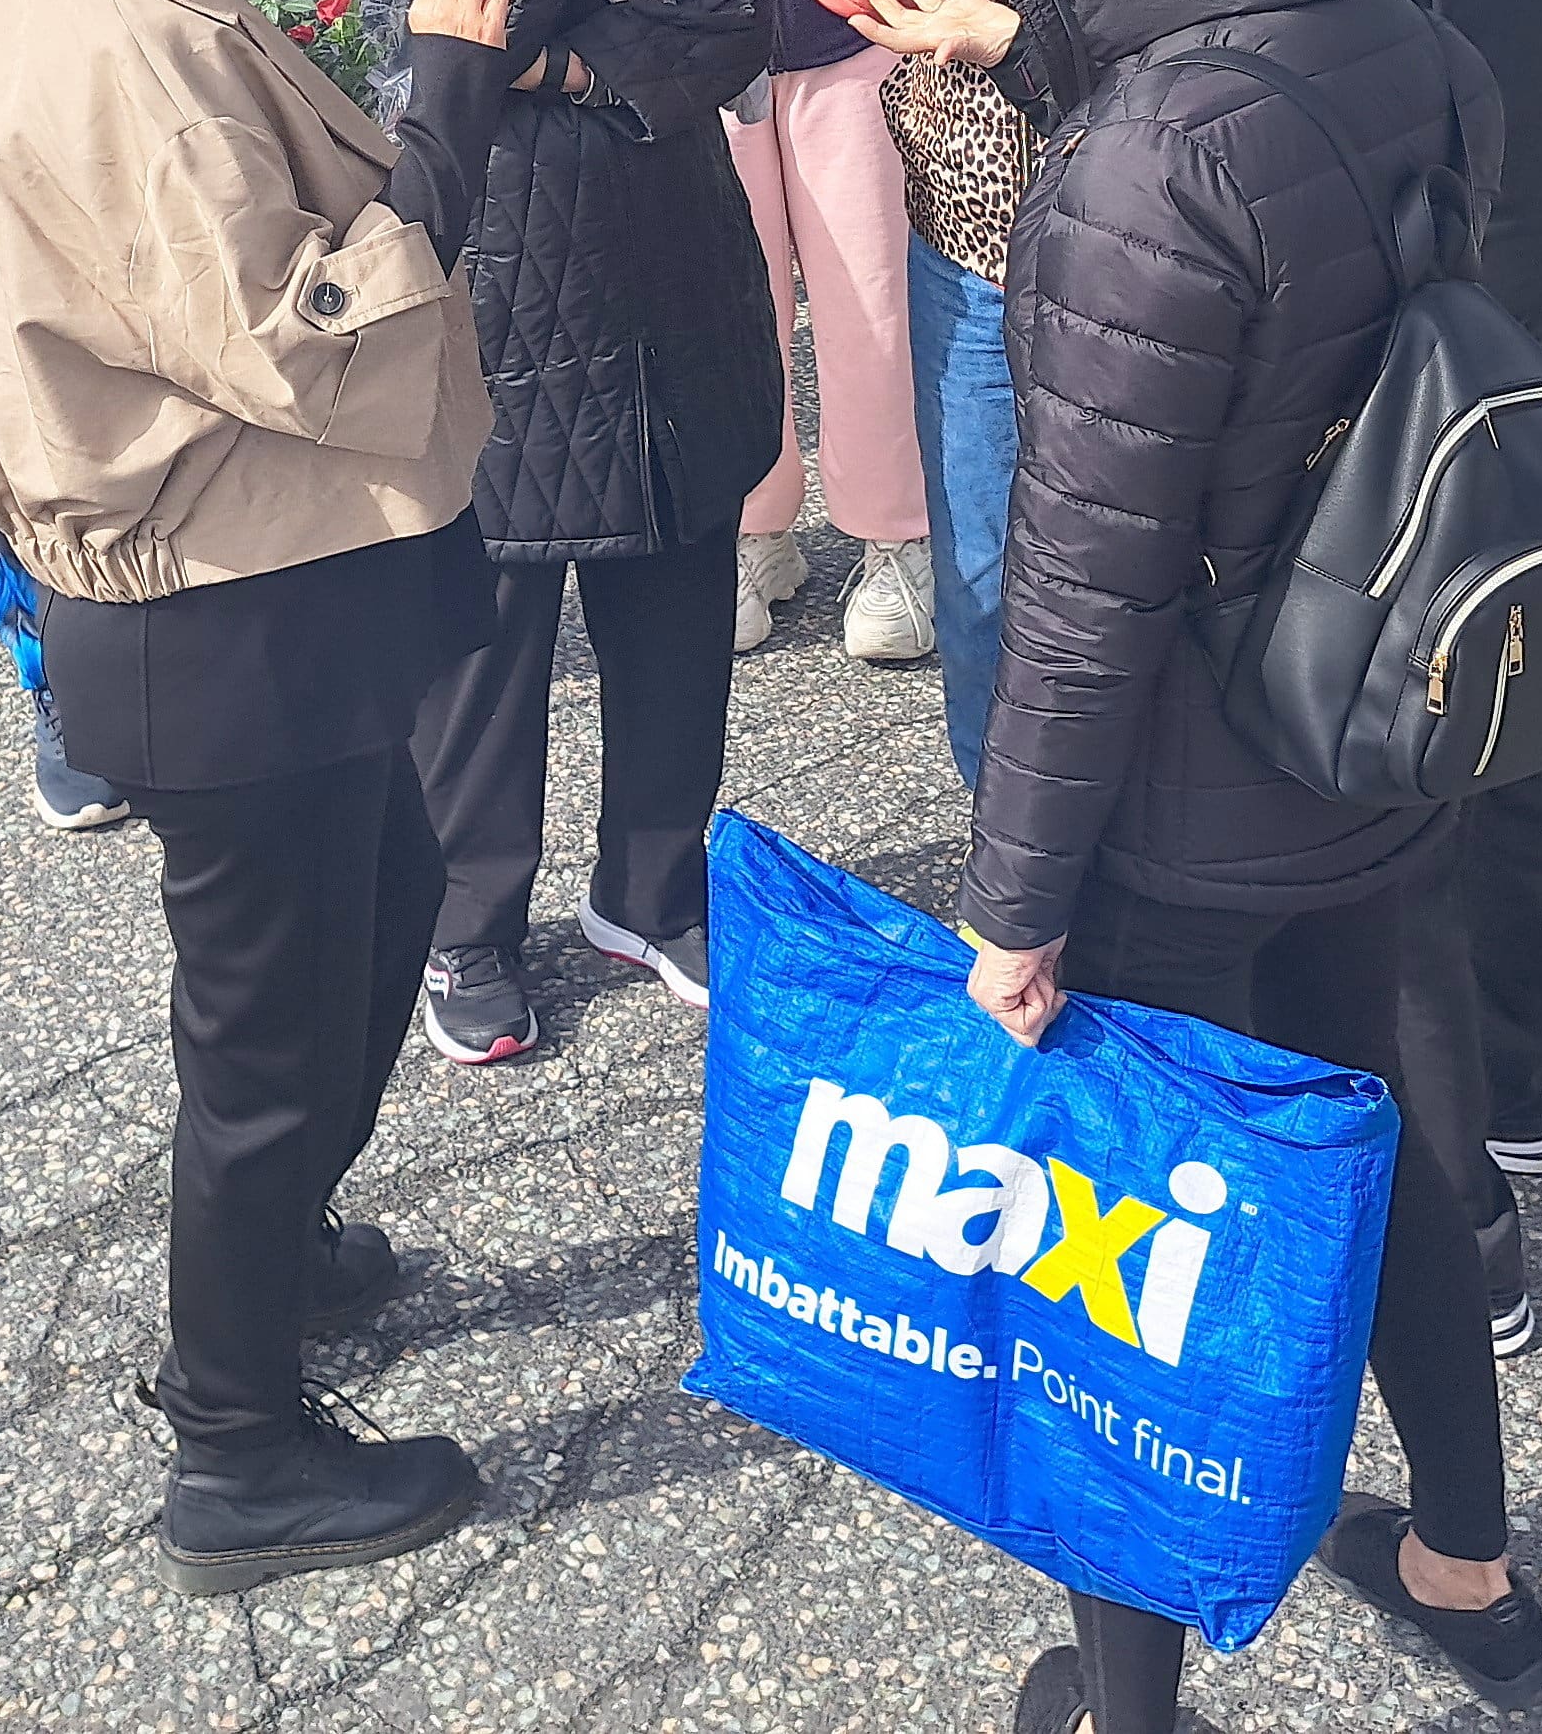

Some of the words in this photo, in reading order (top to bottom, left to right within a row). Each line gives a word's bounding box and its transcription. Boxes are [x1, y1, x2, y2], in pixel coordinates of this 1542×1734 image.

[780, 1077, 1228, 1368] maxi
[713, 1229, 998, 1380] Imbattable.
[1011, 1337, 1121, 1446] Point
[1132, 1418, 1252, 1506] final.
